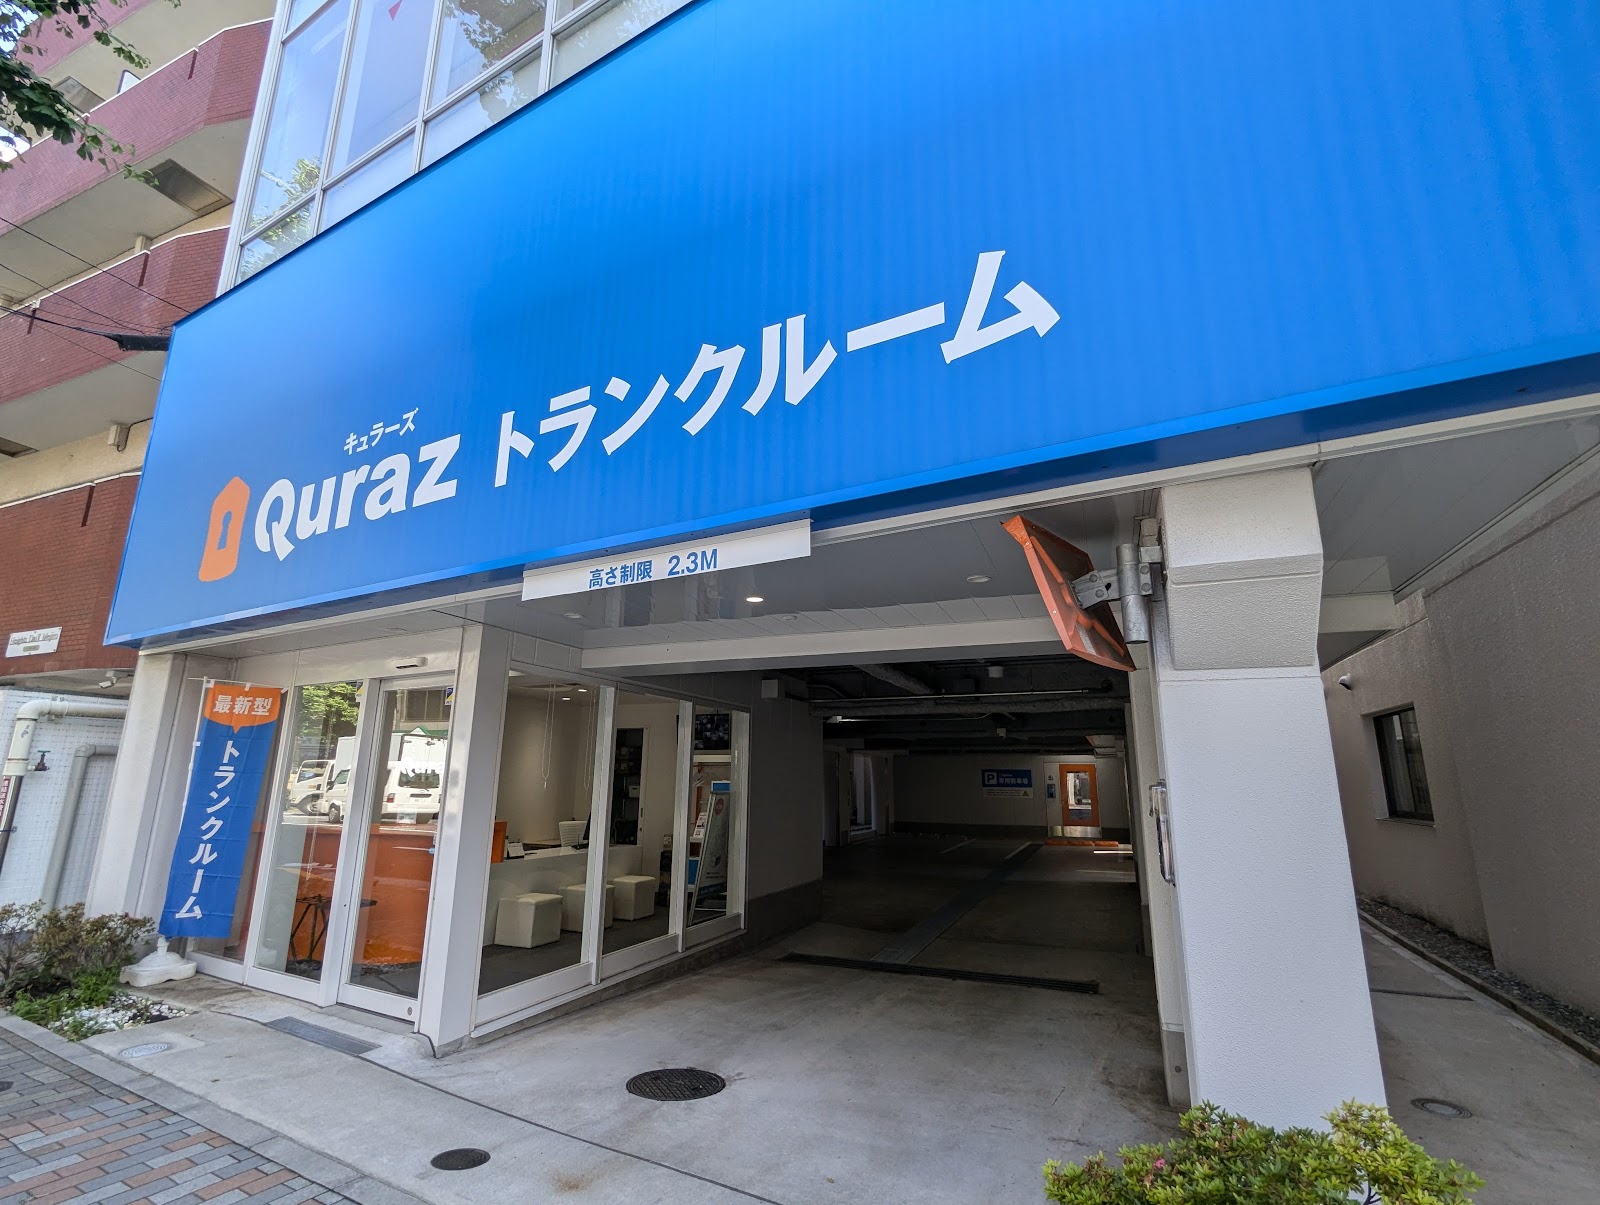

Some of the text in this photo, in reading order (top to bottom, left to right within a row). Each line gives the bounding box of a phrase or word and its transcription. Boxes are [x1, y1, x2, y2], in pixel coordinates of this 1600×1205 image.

[494, 250, 1061, 488] トランクルーム
[343, 407, 419, 456] キュラーズ
[254, 433, 461, 562] Quraz
[588, 548, 718, 589] 高さ制限 2.3M
[212, 694, 273, 716] 最新型
[174, 740, 240, 920] トランクルーム
